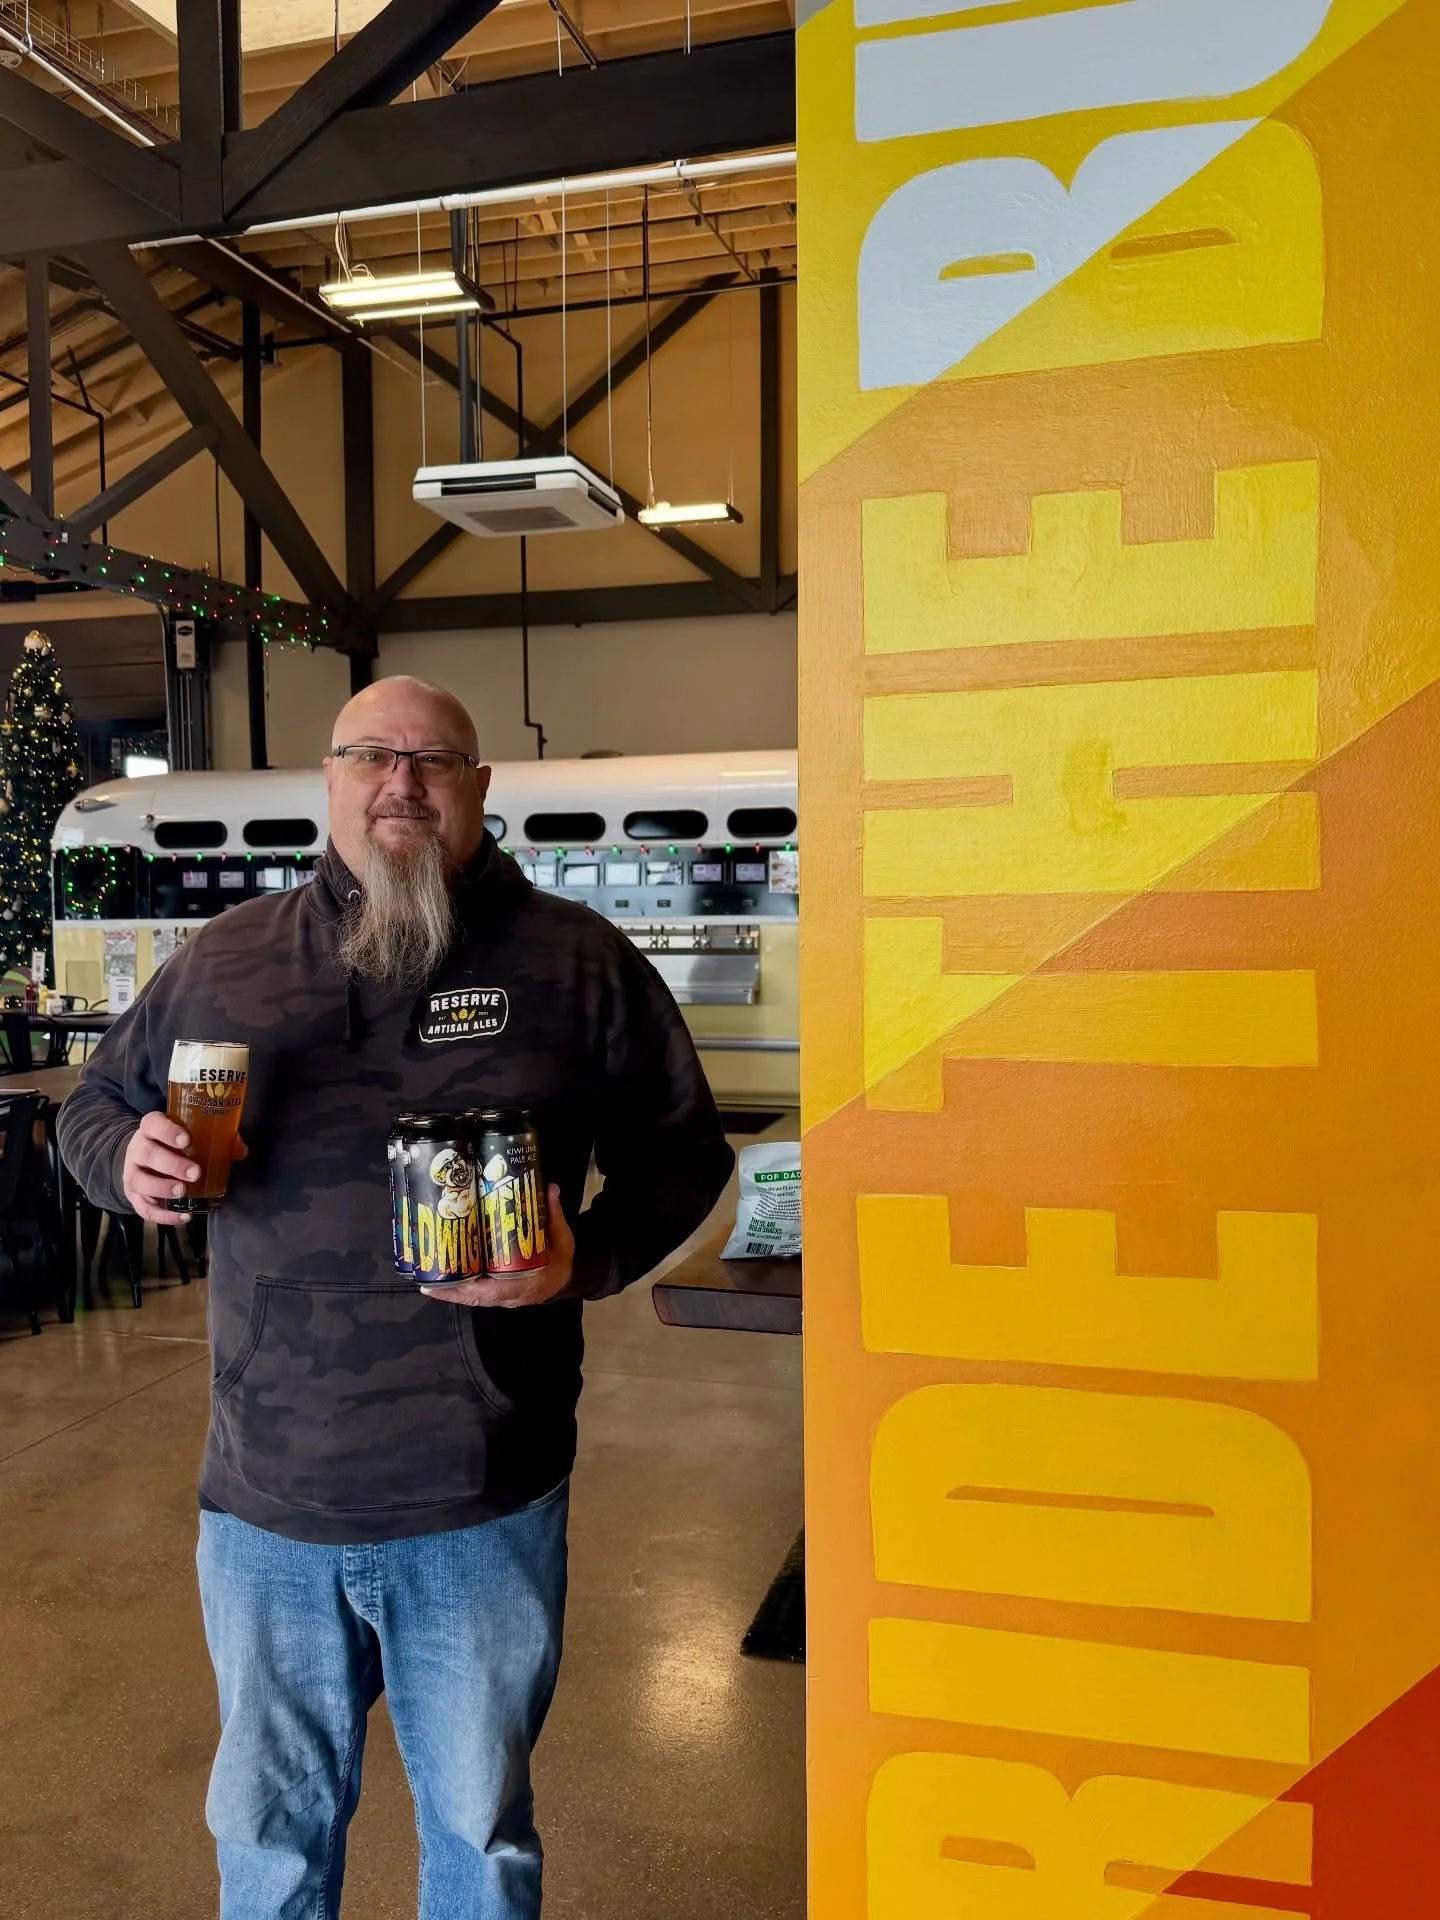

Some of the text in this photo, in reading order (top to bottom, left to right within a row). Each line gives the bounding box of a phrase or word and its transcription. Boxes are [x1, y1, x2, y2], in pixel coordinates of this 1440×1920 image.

[861, 460, 1320, 1113] THE
[431, 993, 500, 1013] RESERVE
[427, 1018, 498, 1035] ARTISAN ALES
[187, 1095, 224, 1107] ARTISAN
[507, 1146, 524, 1155] KIWI
[510, 1155, 526, 1164] PALE
[857, 1194, 1319, 1920] RIDE
